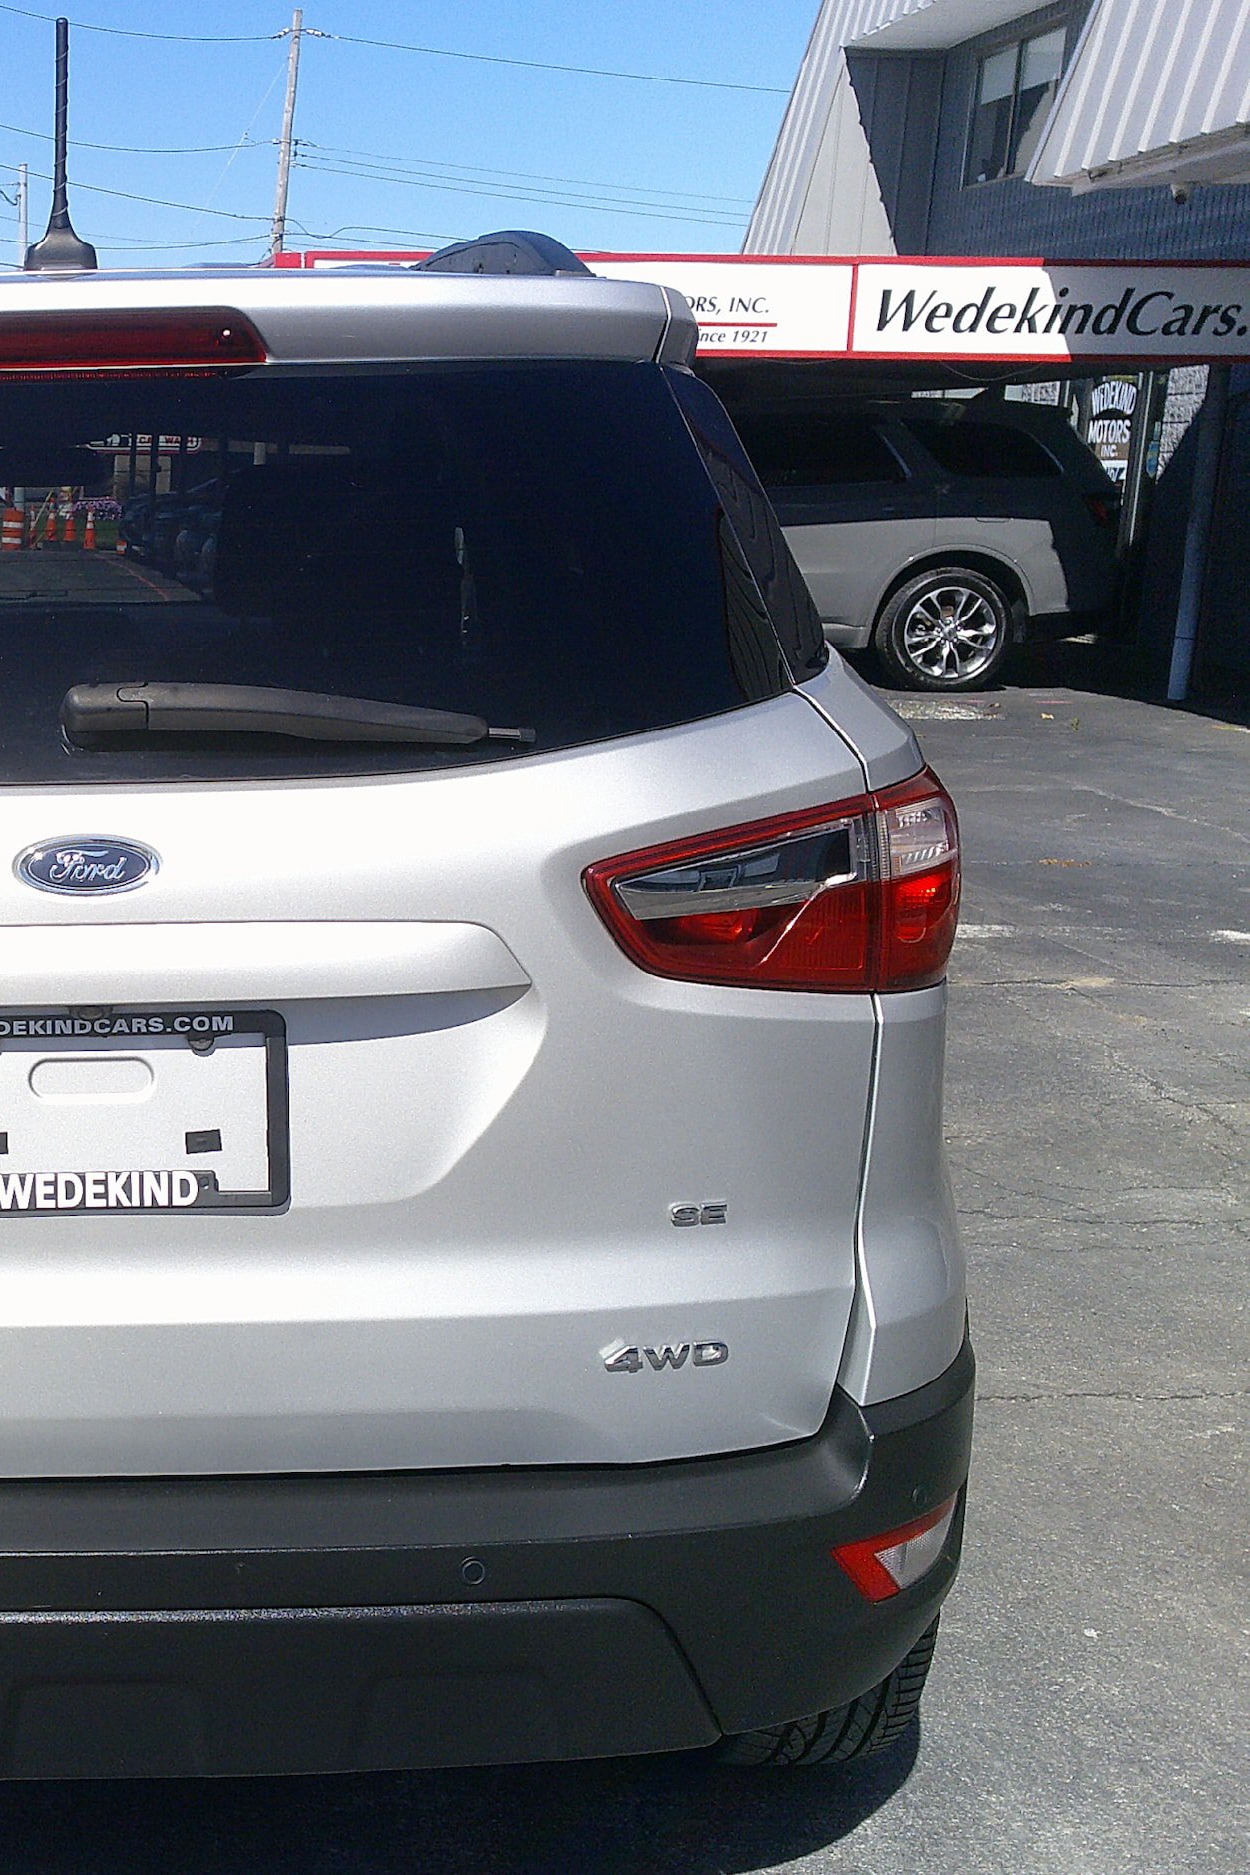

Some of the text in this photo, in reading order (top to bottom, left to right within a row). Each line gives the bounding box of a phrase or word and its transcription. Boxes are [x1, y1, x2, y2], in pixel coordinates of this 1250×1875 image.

[685, 295, 770, 316] ORS, INC.
[875, 286, 1248, 337] WedekindCars.
[698, 328, 768, 343] ince 1921
[1091, 380, 1138, 417] WEDEKIND
[1087, 419, 1132, 444] MOTORS
[1100, 444, 1119, 458] INC.
[50, 849, 128, 883] Ford
[669, 1200, 728, 1228] SE
[602, 1338, 730, 1374] 4WD
